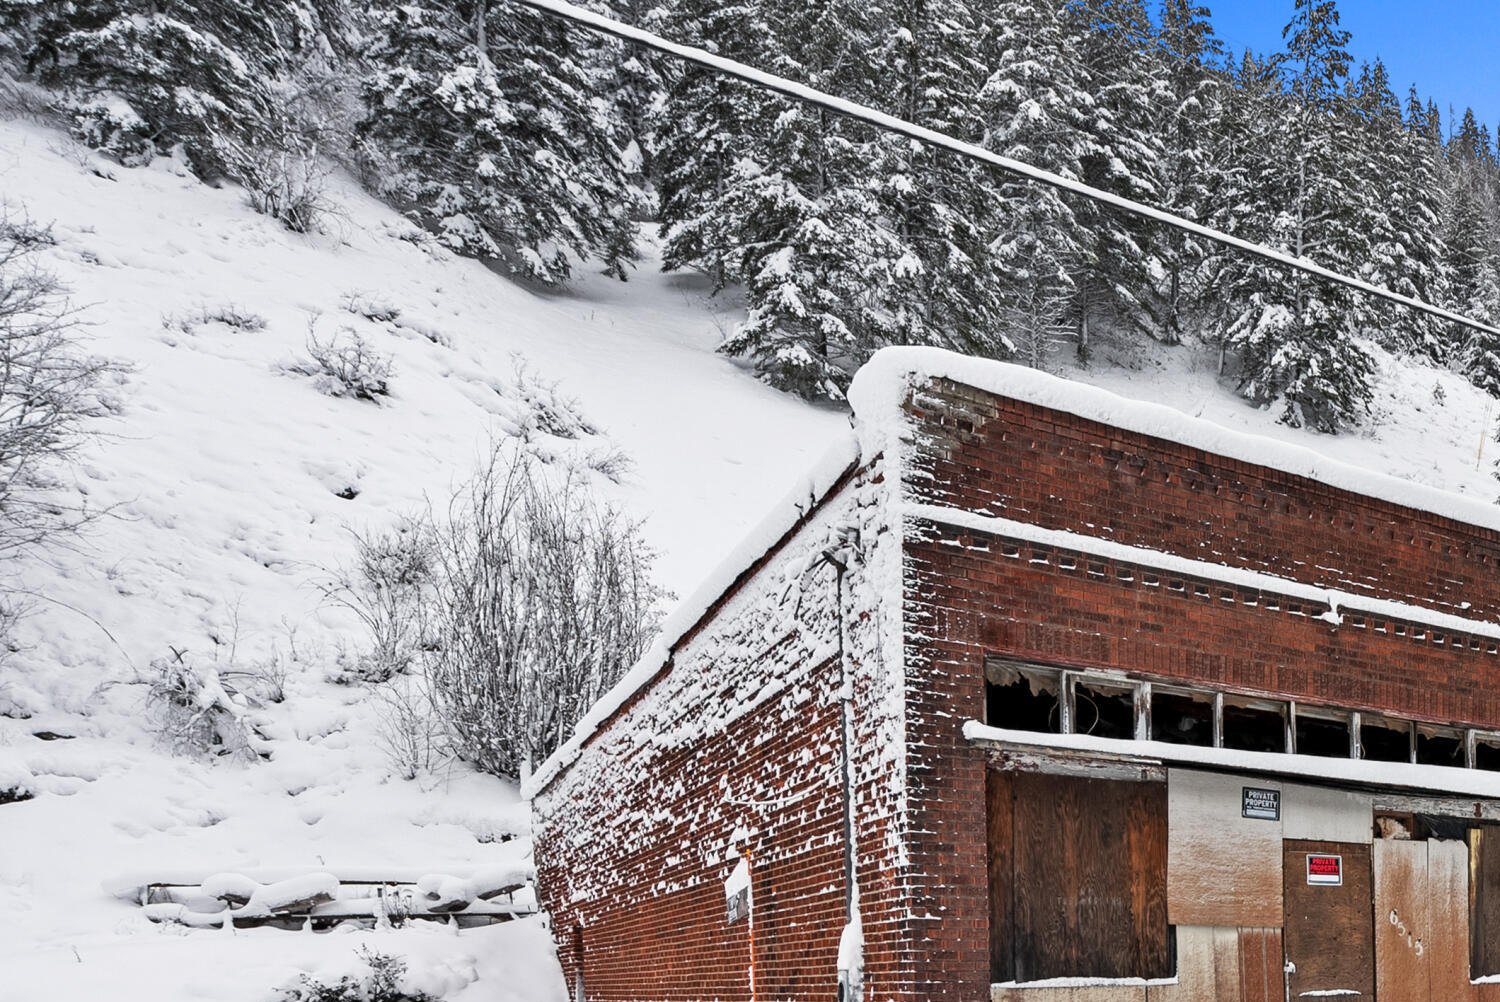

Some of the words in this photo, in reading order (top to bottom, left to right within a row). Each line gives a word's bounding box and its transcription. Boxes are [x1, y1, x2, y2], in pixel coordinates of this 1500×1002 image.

[1248, 791, 1275, 801] PRIVATE
[1245, 798, 1277, 808] PROPERTY
[1312, 857, 1336, 865] PRIVATE
[1309, 864, 1339, 873] PROPERTY
